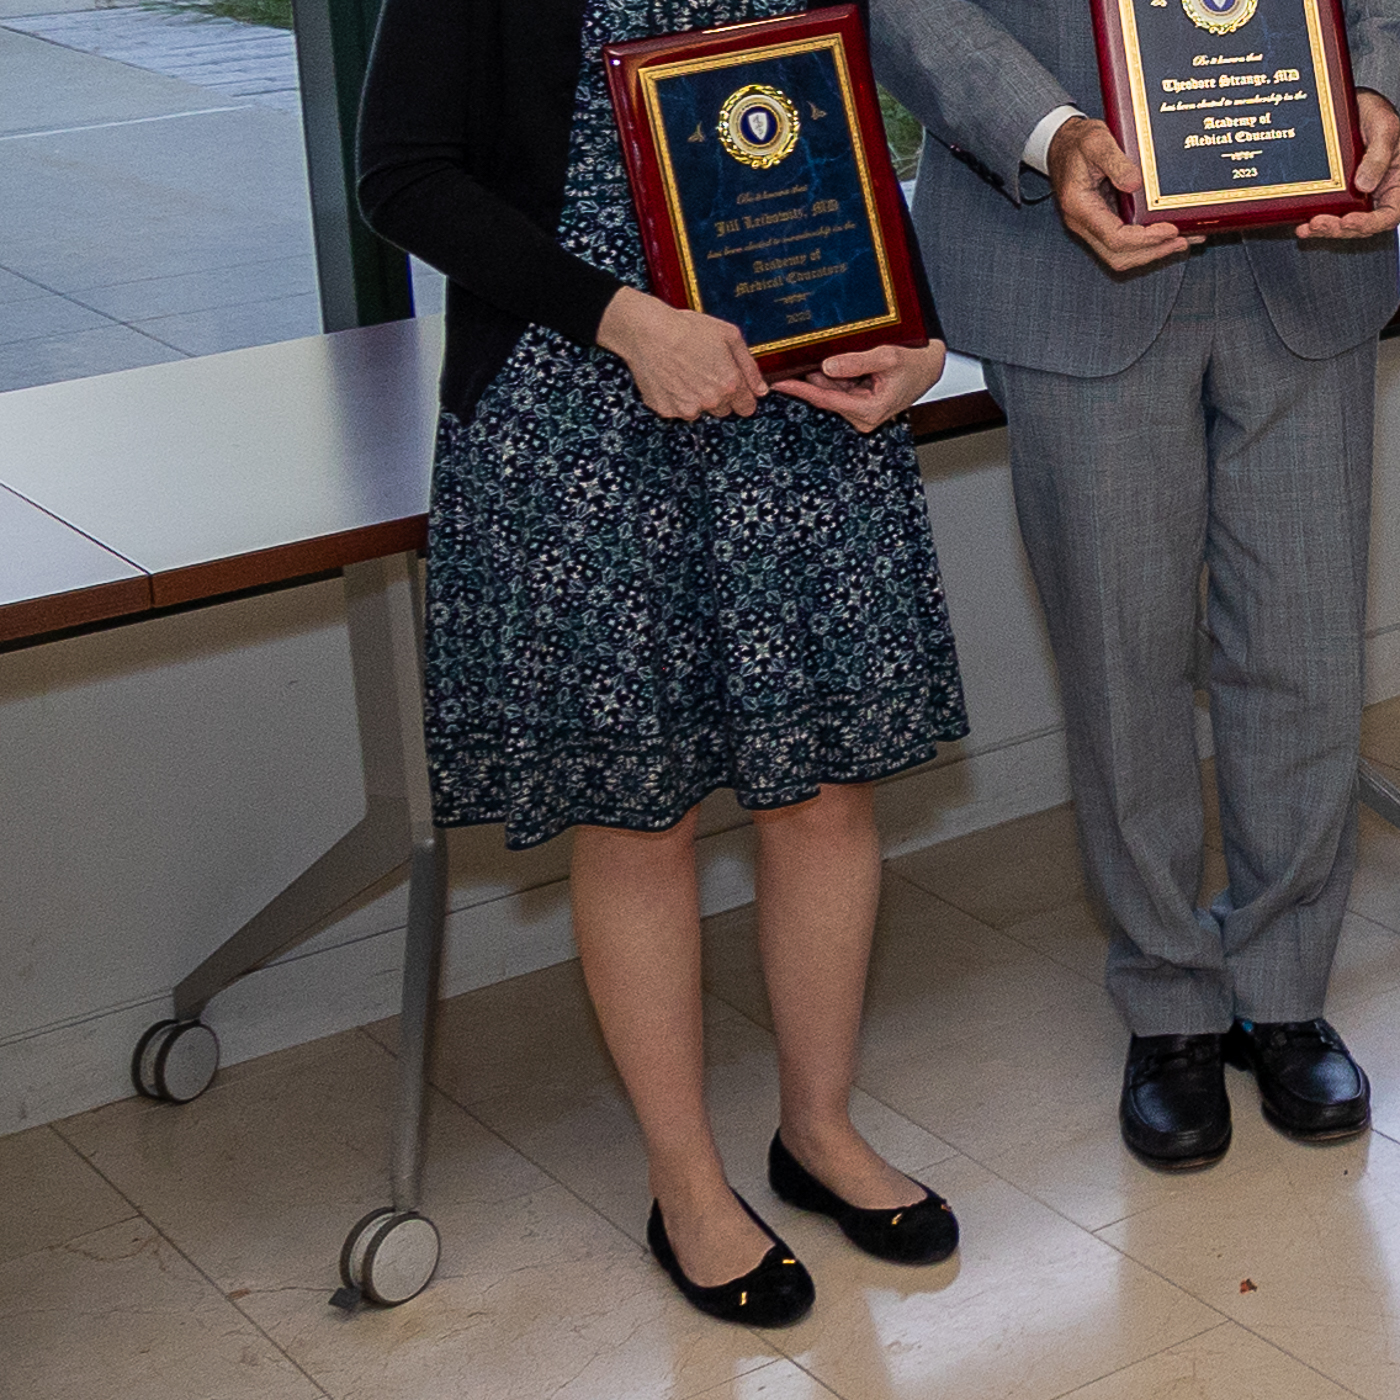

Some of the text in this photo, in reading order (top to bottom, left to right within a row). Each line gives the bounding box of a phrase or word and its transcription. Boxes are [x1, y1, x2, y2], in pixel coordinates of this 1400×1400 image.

[1162, 69, 1300, 93] Theodore Strange, MD
[1203, 112, 1272, 130] Academy of
[1184, 128, 1296, 149] Medical Educators
[1232, 167, 1258, 180] 2023
